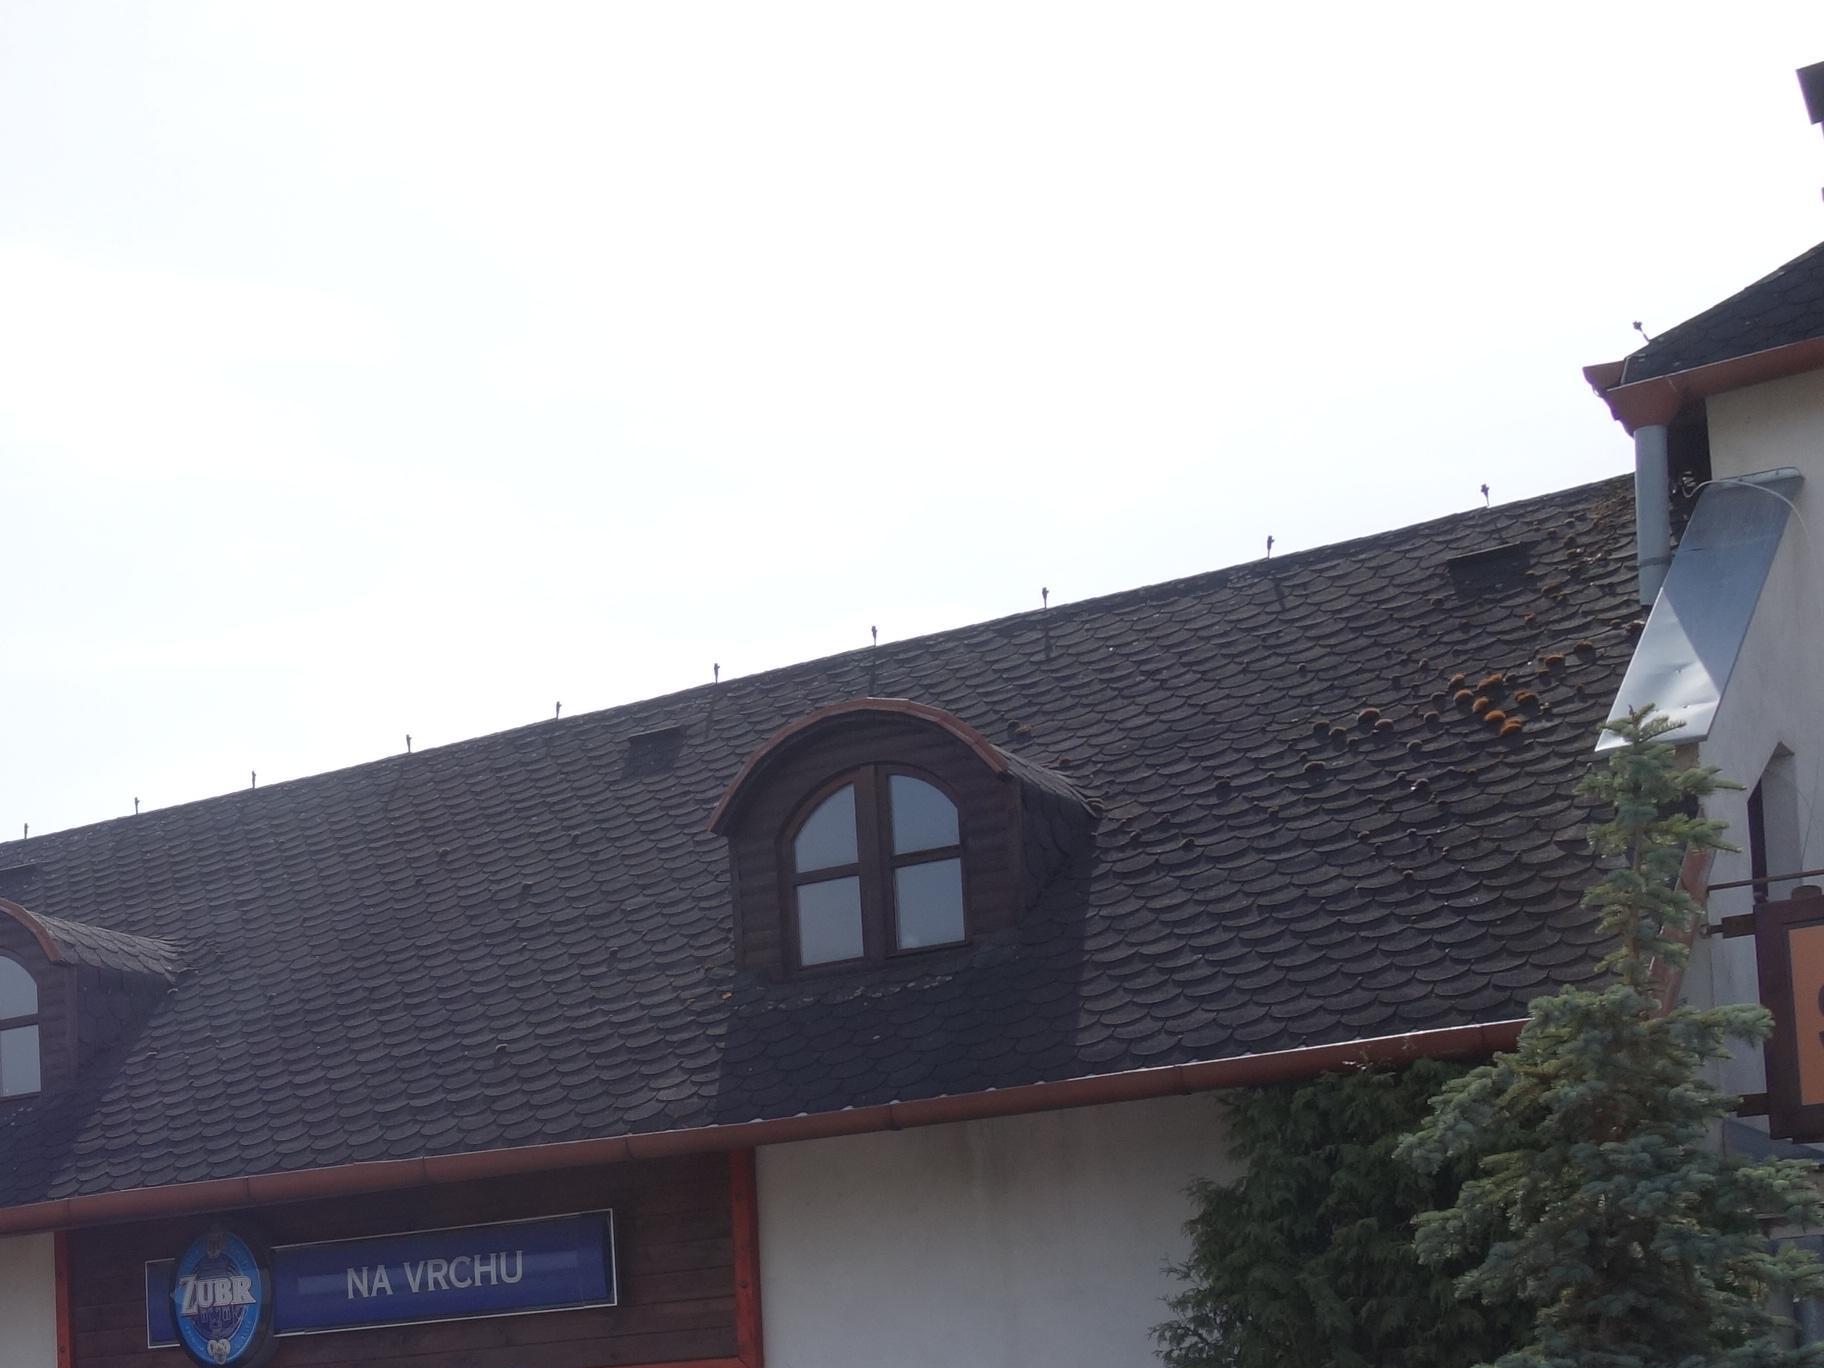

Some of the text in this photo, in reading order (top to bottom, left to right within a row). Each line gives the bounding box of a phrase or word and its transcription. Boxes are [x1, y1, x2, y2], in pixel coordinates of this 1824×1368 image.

[179, 1275, 256, 1315] ZUBR
[347, 1250, 524, 1299] NA VRCHU
